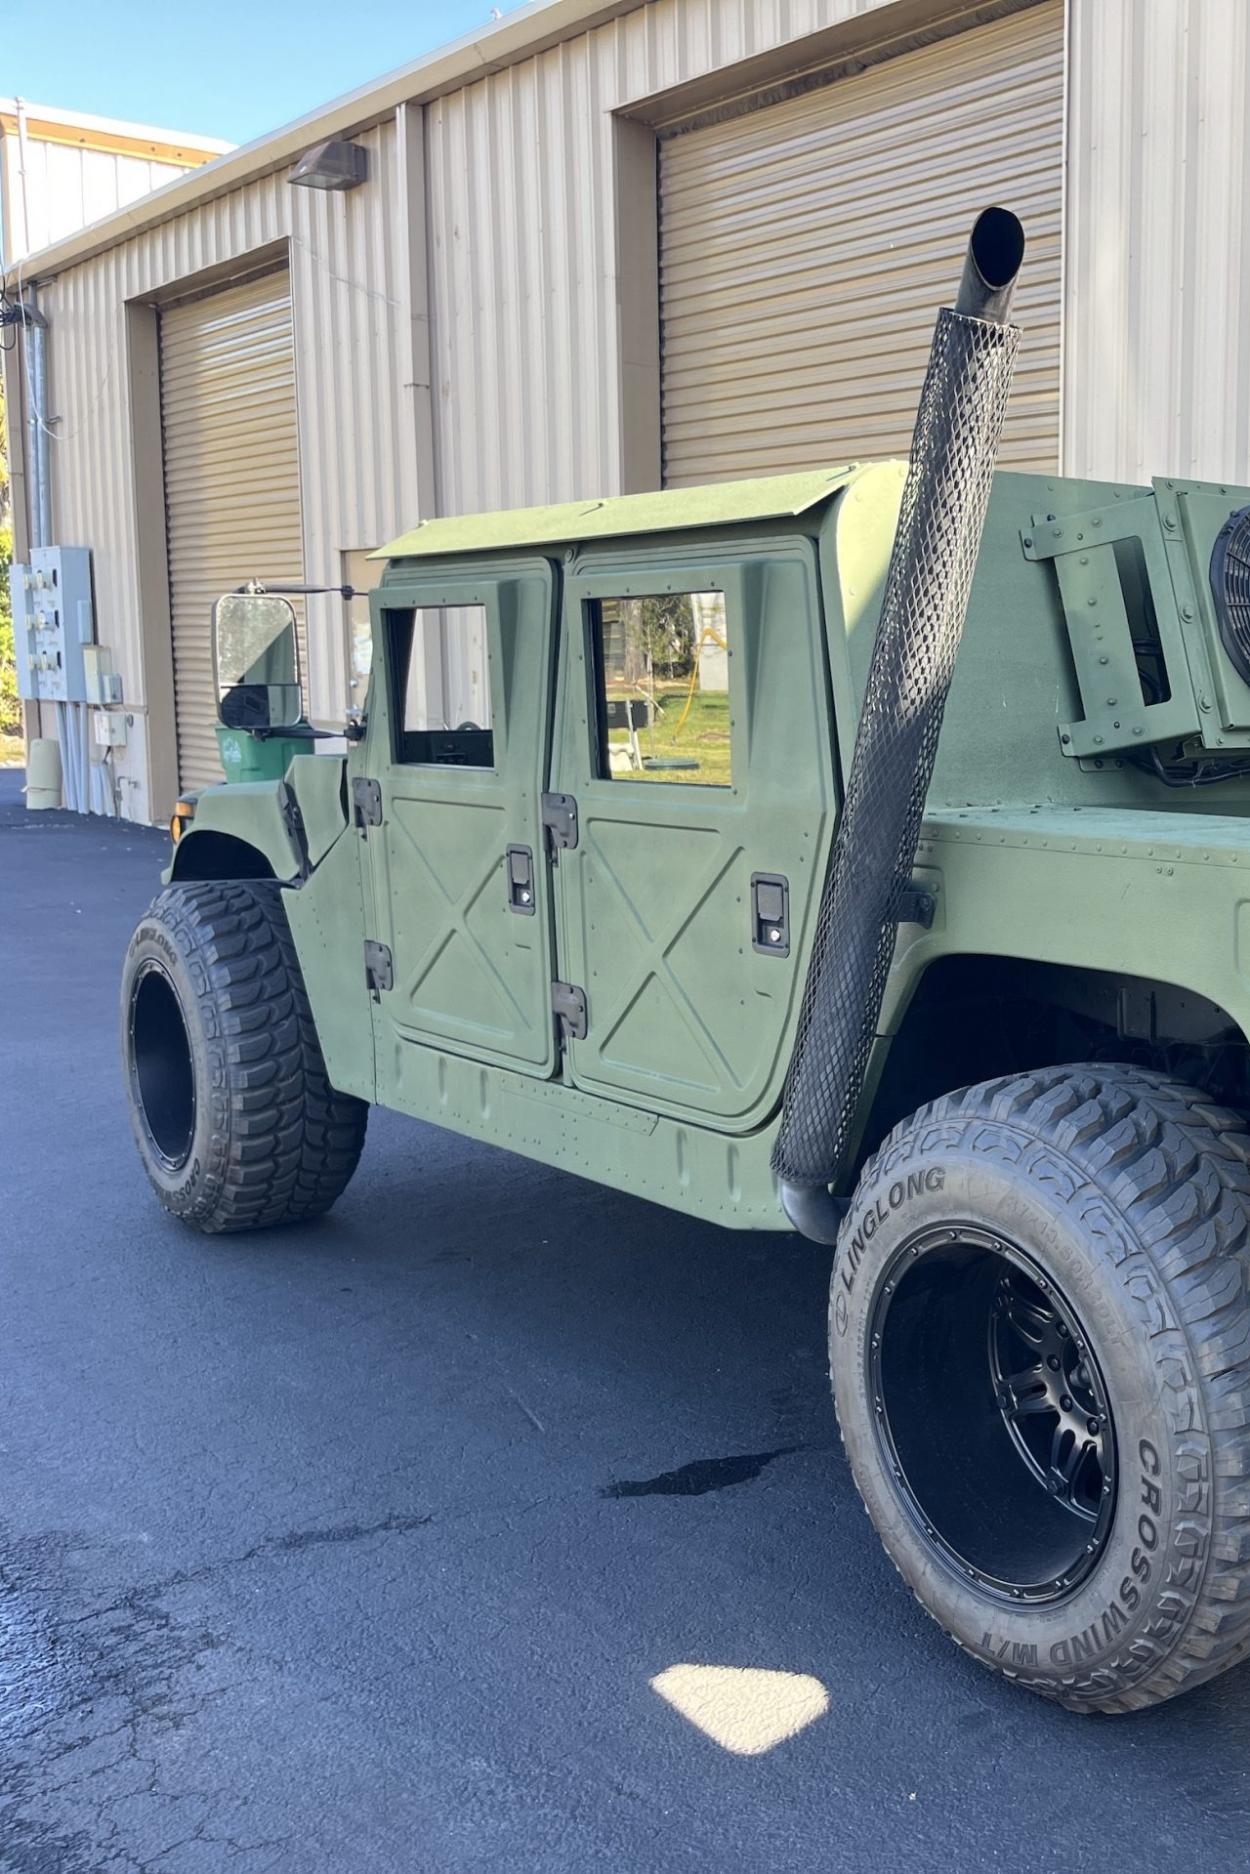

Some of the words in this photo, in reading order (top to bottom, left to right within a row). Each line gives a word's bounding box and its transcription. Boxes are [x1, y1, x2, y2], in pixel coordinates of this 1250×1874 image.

[841, 1166, 946, 1296] LINGLONG
[1050, 1438, 1162, 1668] CROSSWIND
[976, 1631, 1039, 1667] M/T
